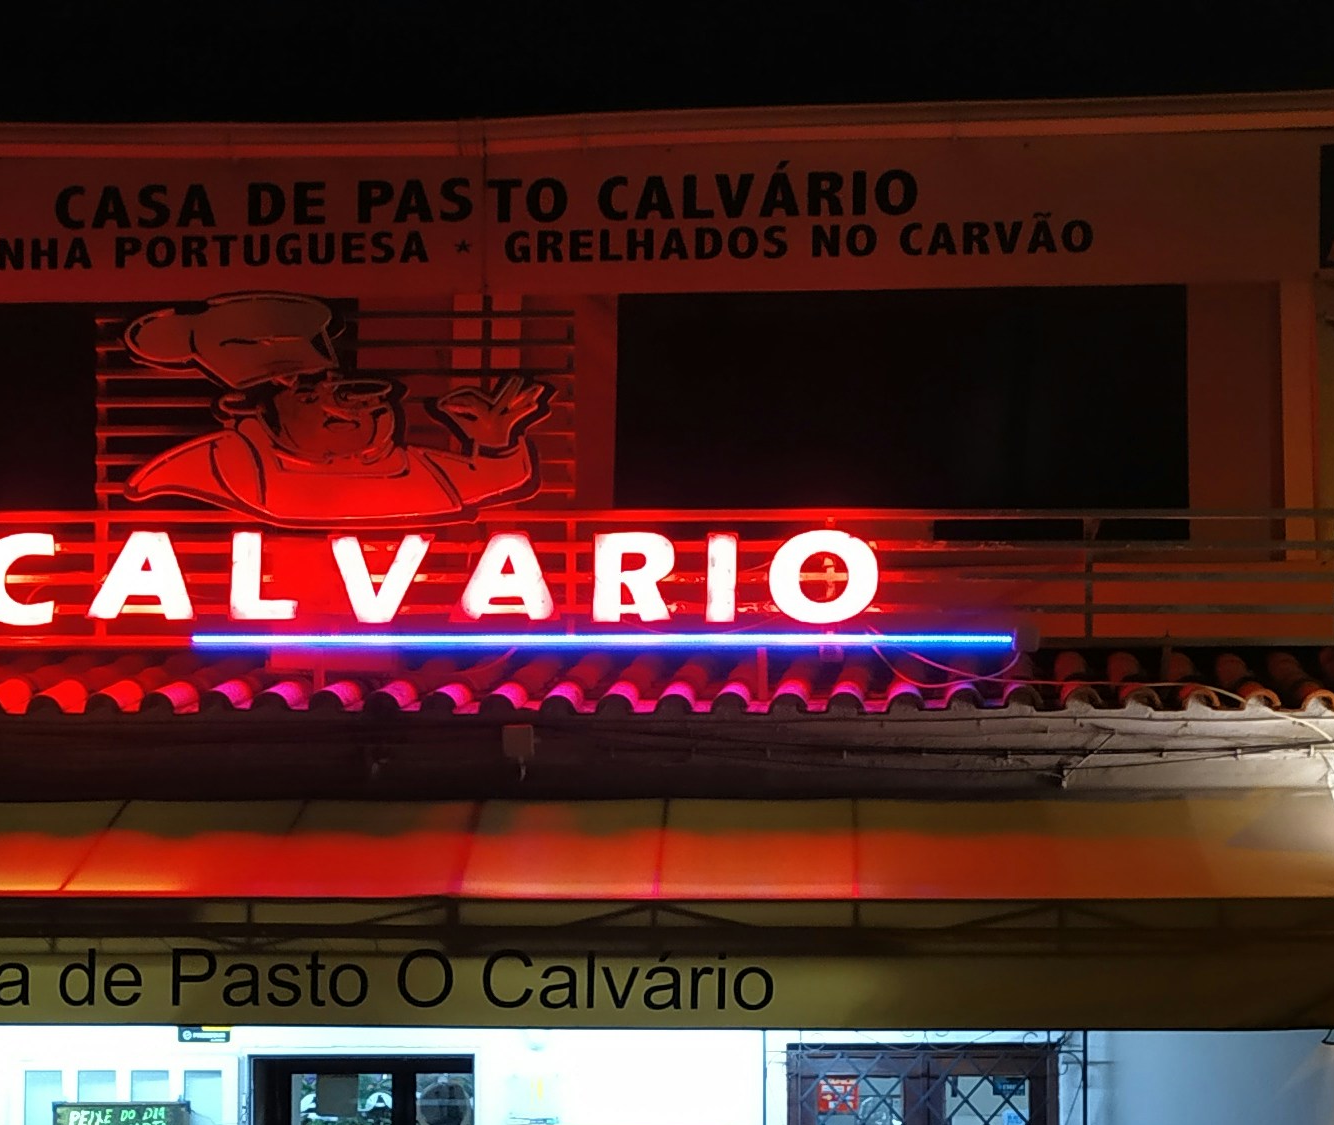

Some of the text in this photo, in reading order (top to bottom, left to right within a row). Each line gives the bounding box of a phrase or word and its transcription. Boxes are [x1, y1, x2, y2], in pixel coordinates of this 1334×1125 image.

[55, 160, 918, 230] CASA DE PASTO CALVÁRIO
[115, 231, 429, 268] PORTUGUESA
[505, 225, 787, 263] GRELHADOS
[812, 225, 876, 258] NO
[900, 213, 1093, 257] CARVÃO
[59, 949, 142, 1006] de
[172, 949, 369, 1008] Pasto
[397, 949, 454, 1008] O
[482, 949, 774, 1011] Calvário
[121, 1109, 136, 1122] DO
